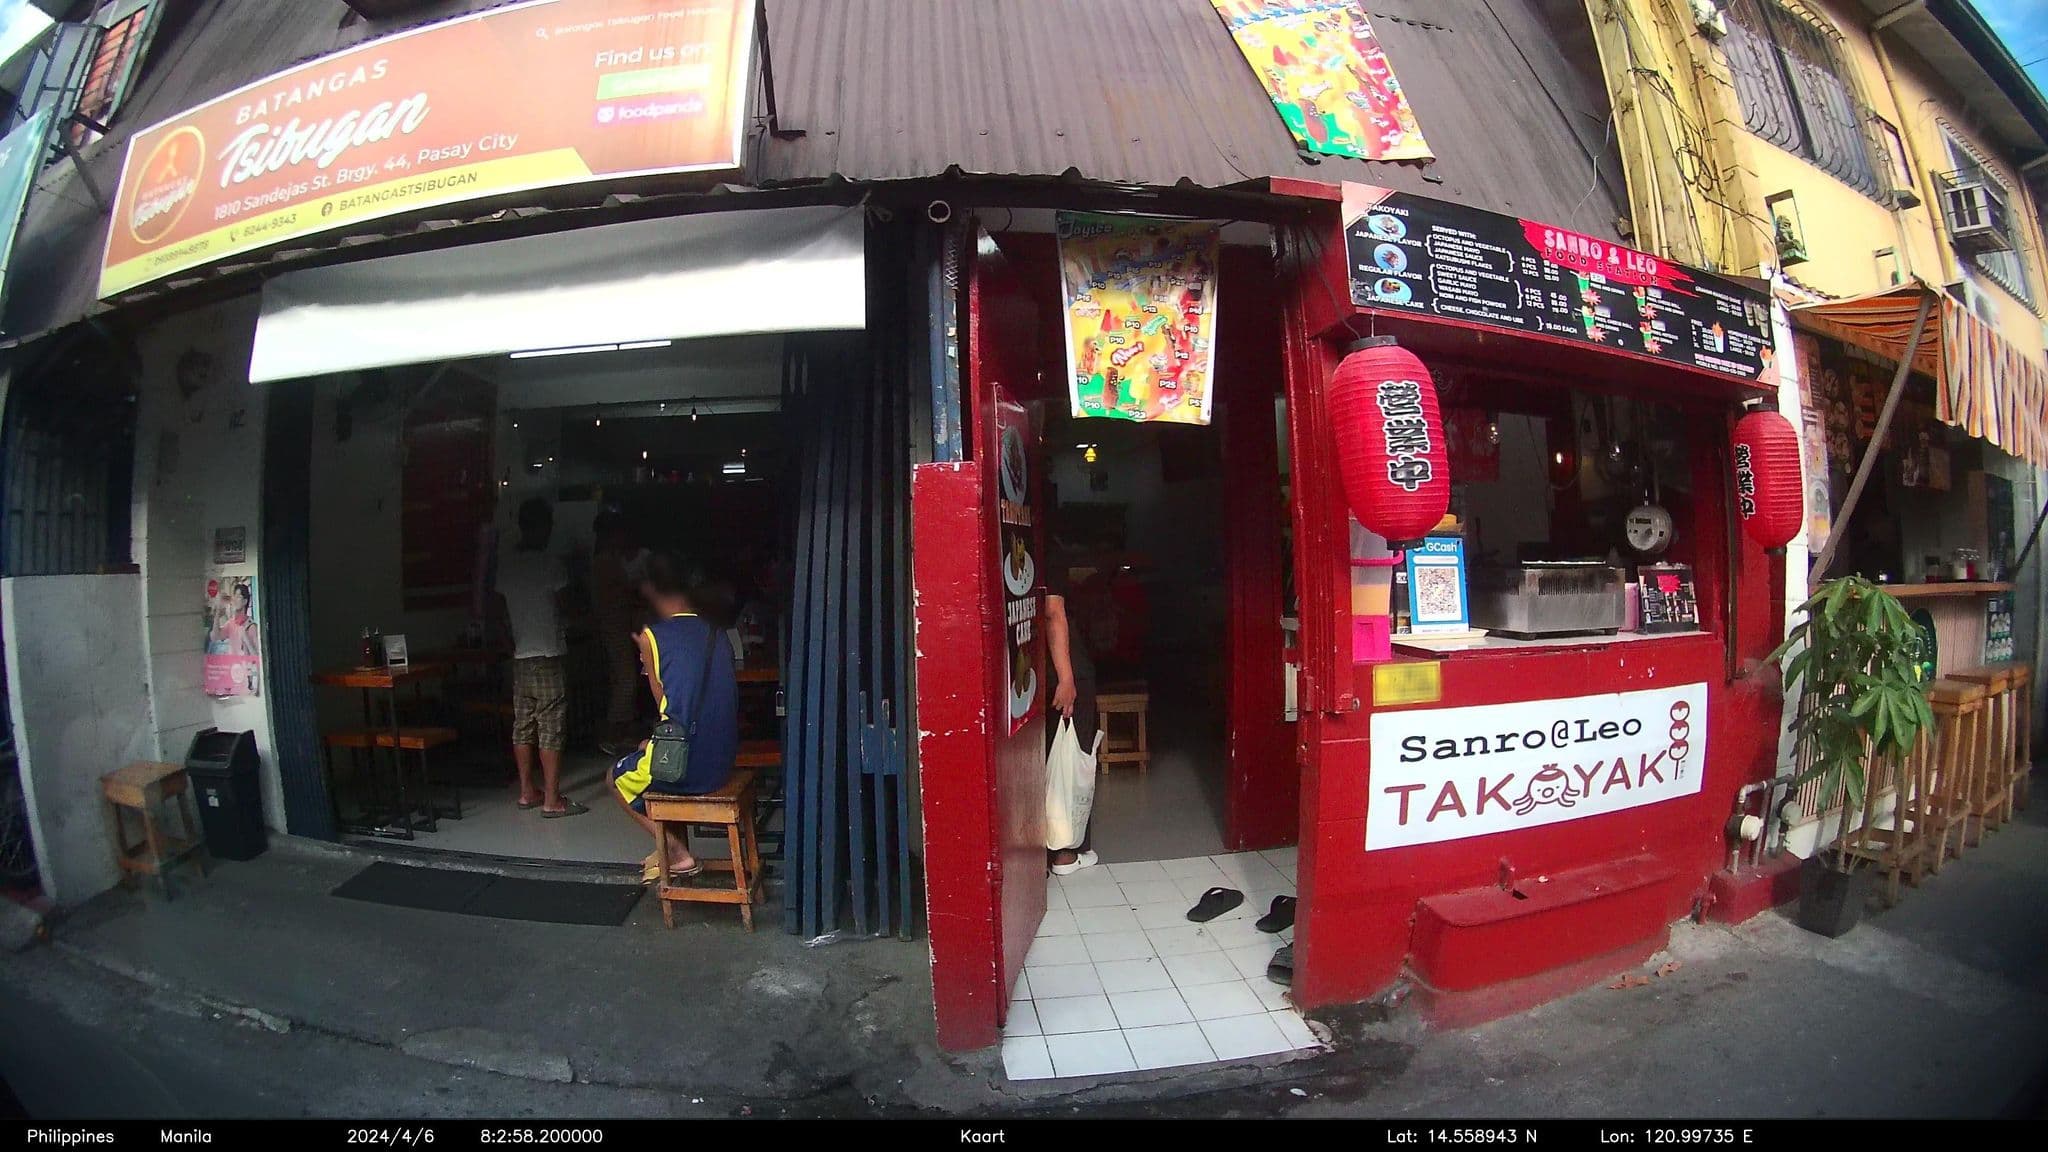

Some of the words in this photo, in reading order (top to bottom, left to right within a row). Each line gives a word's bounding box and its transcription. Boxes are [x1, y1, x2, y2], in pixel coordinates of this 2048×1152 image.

[594, 46, 643, 68] Find
[649, 45, 675, 61] us
[235, 59, 389, 126] BATANGAS
[217, 92, 431, 189] Tsibugan
[214, 202, 241, 221] 1810
[242, 181, 308, 212] Sandejas
[312, 173, 332, 190] St.
[336, 162, 378, 186] Brgy.
[383, 157, 411, 172] 44,
[416, 138, 472, 165] Pasay
[479, 131, 519, 151] City
[339, 172, 478, 212] BATANGASTSIBUGAN
[1544, 229, 1602, 260] SANRO
[1607, 247, 1620, 264] &
[1626, 251, 1657, 275] LEO
[1545, 247, 1587, 266] FOOD
[1597, 261, 1658, 285] STATION
[1425, 542, 1458, 552] GCash
[1007, 596, 1036, 627] JAPANESE
[1399, 718, 1642, 763] Sanro@Leo
